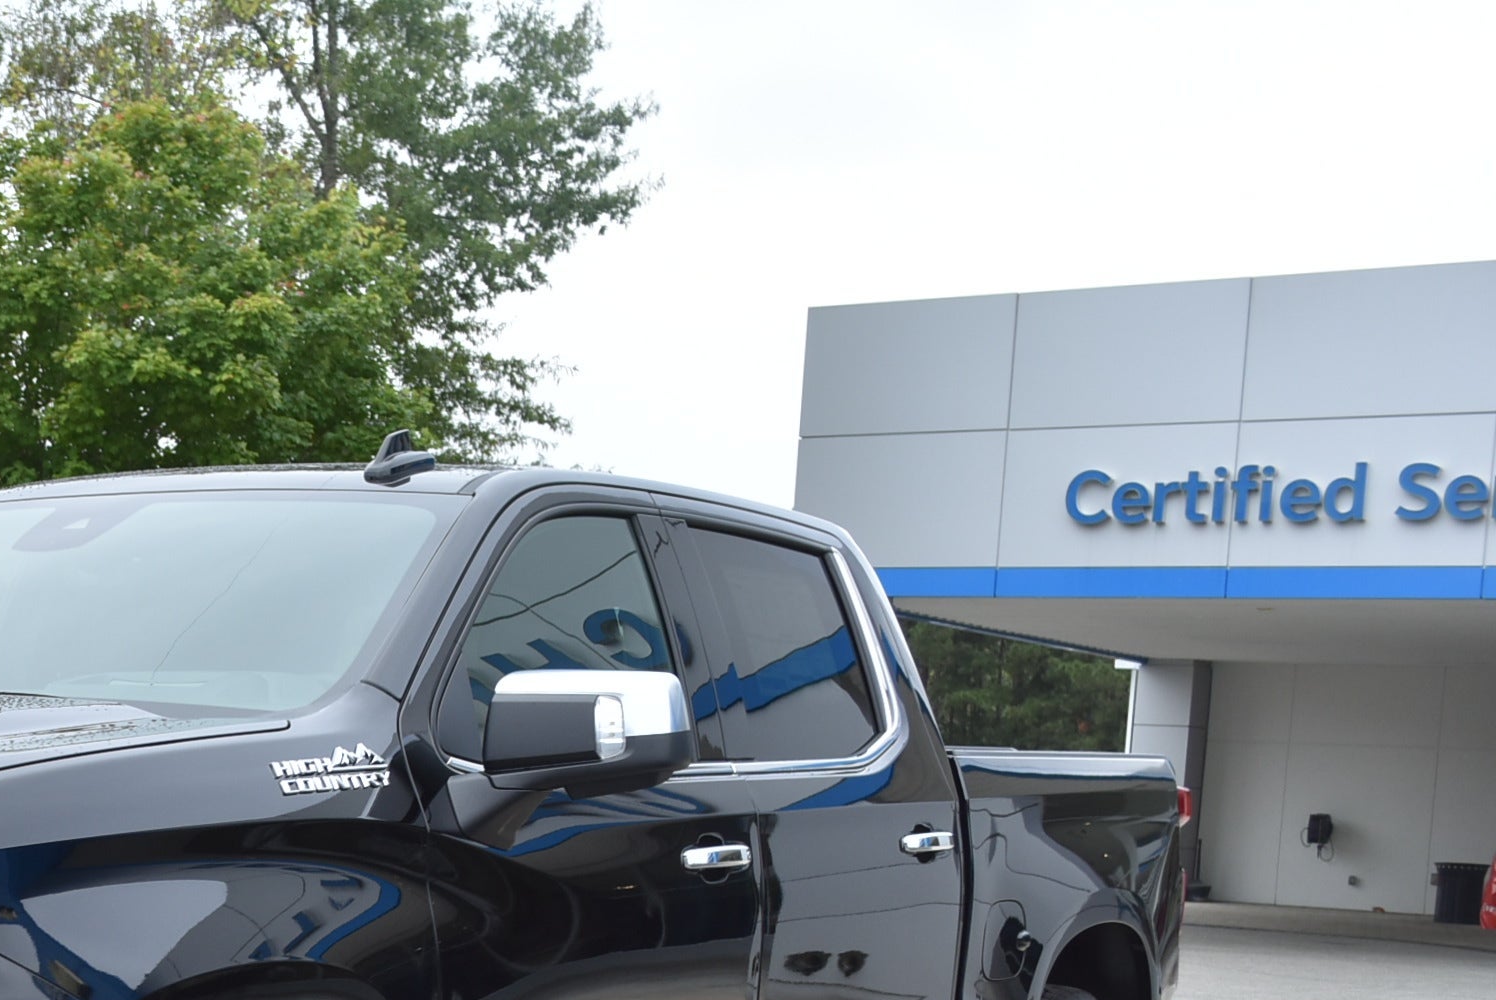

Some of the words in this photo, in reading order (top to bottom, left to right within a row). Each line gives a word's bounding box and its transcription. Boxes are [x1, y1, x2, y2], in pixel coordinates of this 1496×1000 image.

[1065, 461, 1368, 525] Certified
[1395, 462, 1496, 523] Se
[270, 757, 334, 778] HIGH
[280, 771, 391, 795] COUNTRY
